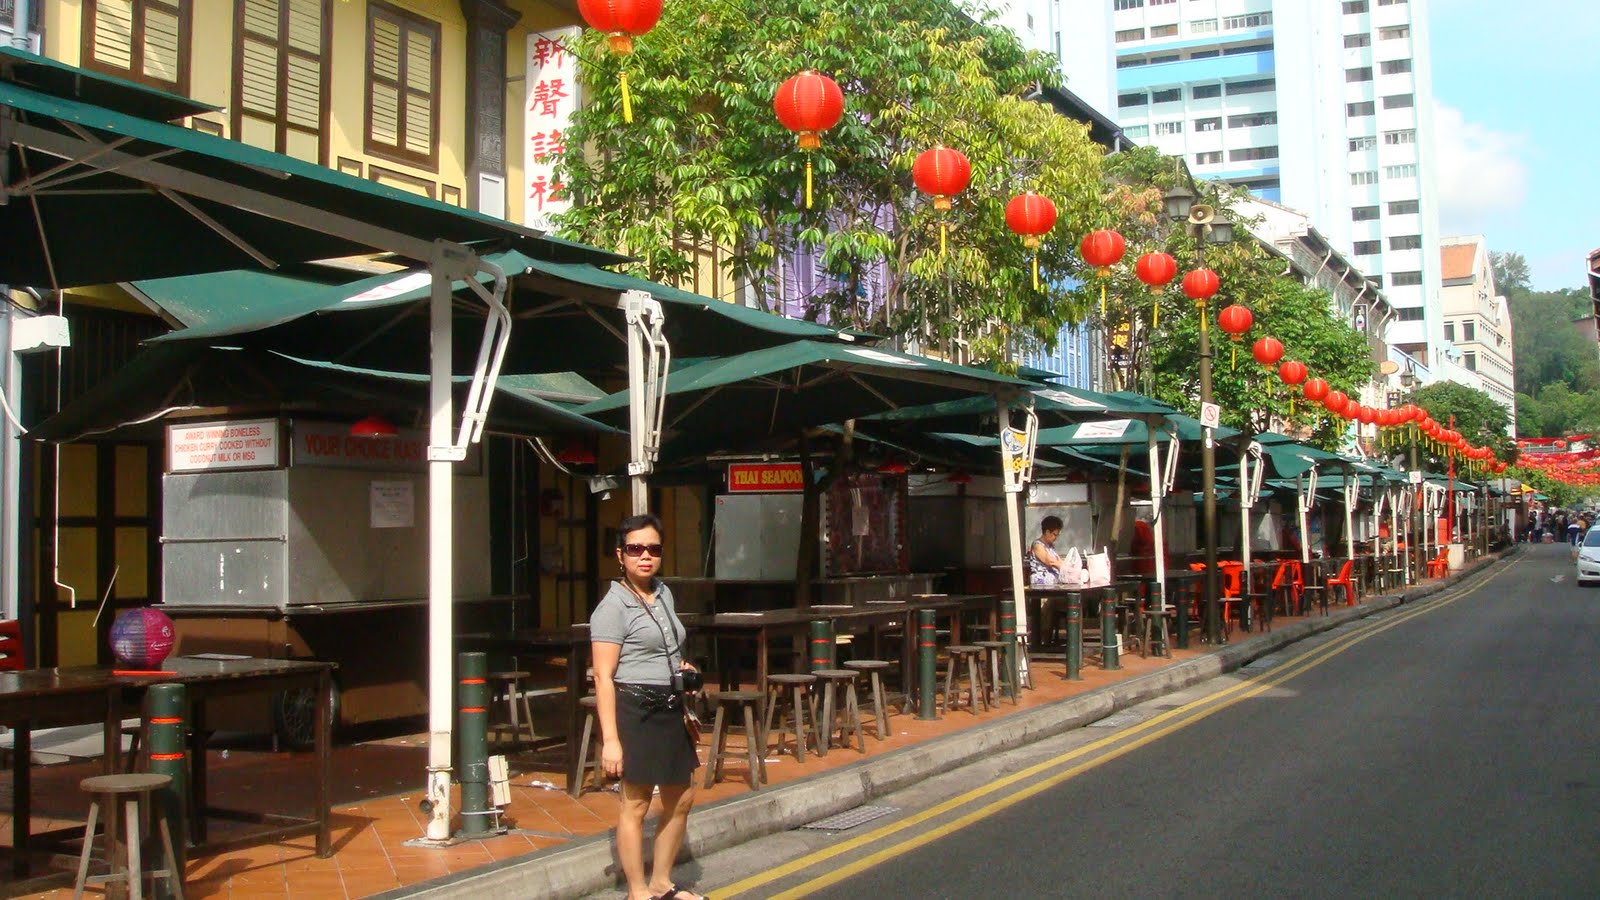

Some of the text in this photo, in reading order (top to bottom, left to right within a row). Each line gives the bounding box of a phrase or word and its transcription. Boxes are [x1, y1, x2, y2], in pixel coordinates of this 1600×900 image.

[185, 427, 261, 440] AWARD WINNING BONELESS
[176, 438, 272, 453] CHICKEN CURRY COOKED WITHOUT
[305, 434, 340, 456] YOUR
[344, 436, 391, 459] CHOICE
[189, 451, 256, 464] COCONUT MILK OR MSG
[734, 470, 759, 484] THAI
